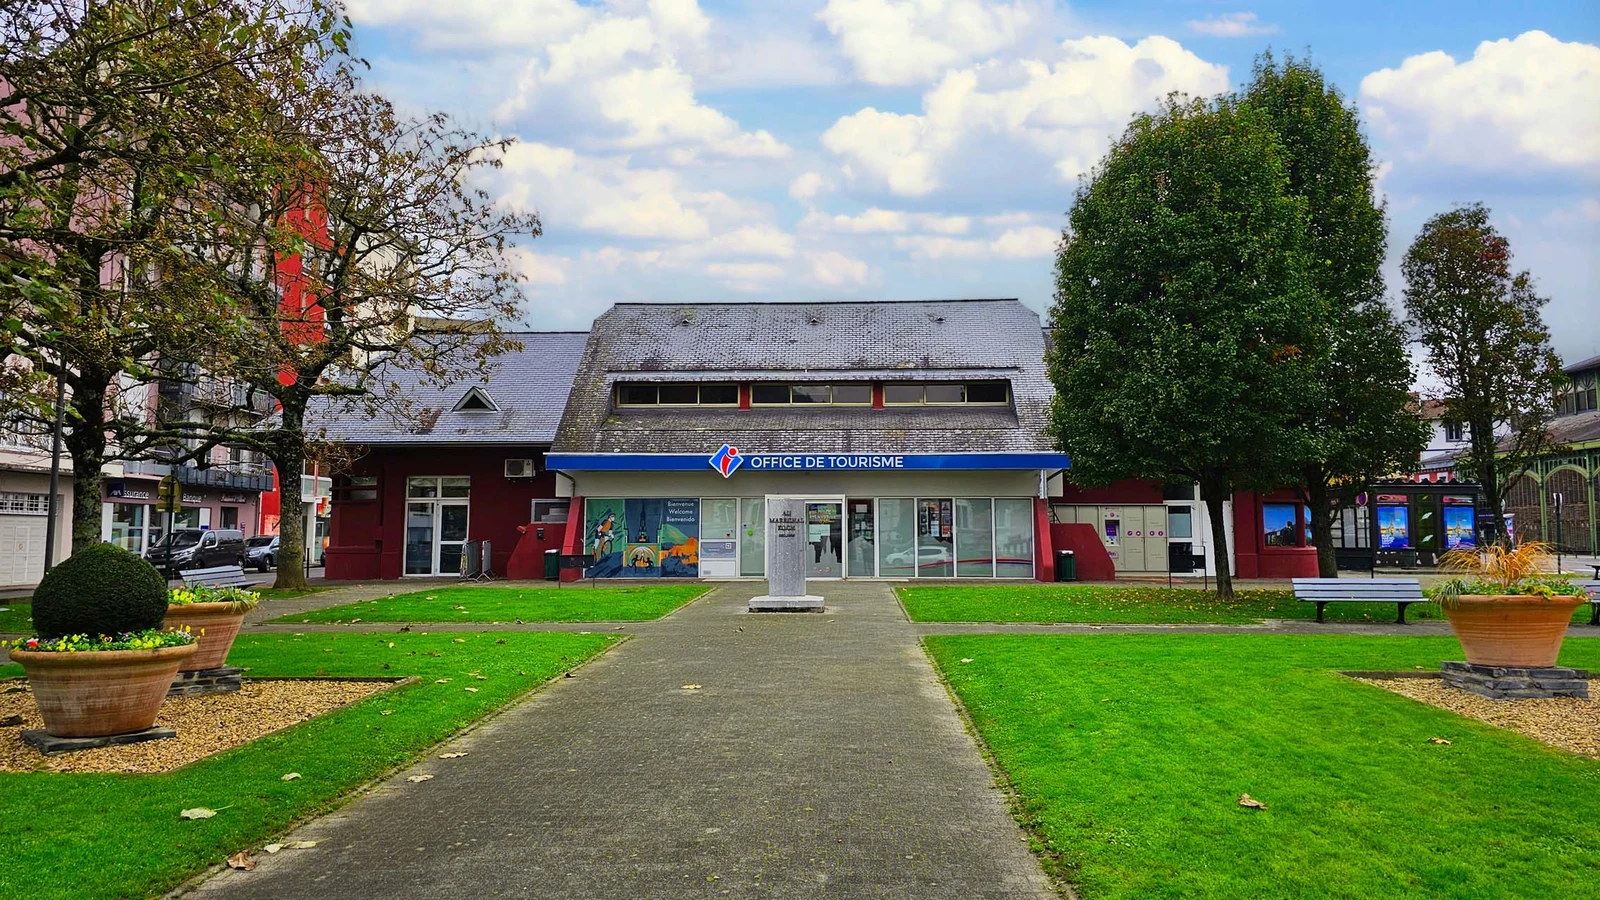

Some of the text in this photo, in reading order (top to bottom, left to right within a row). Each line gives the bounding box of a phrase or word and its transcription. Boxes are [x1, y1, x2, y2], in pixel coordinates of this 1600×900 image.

[751, 456, 904, 468] OFFICE DE TOURISME
[123, 489, 149, 498] ssurance
[182, 493, 202, 504] Banque
